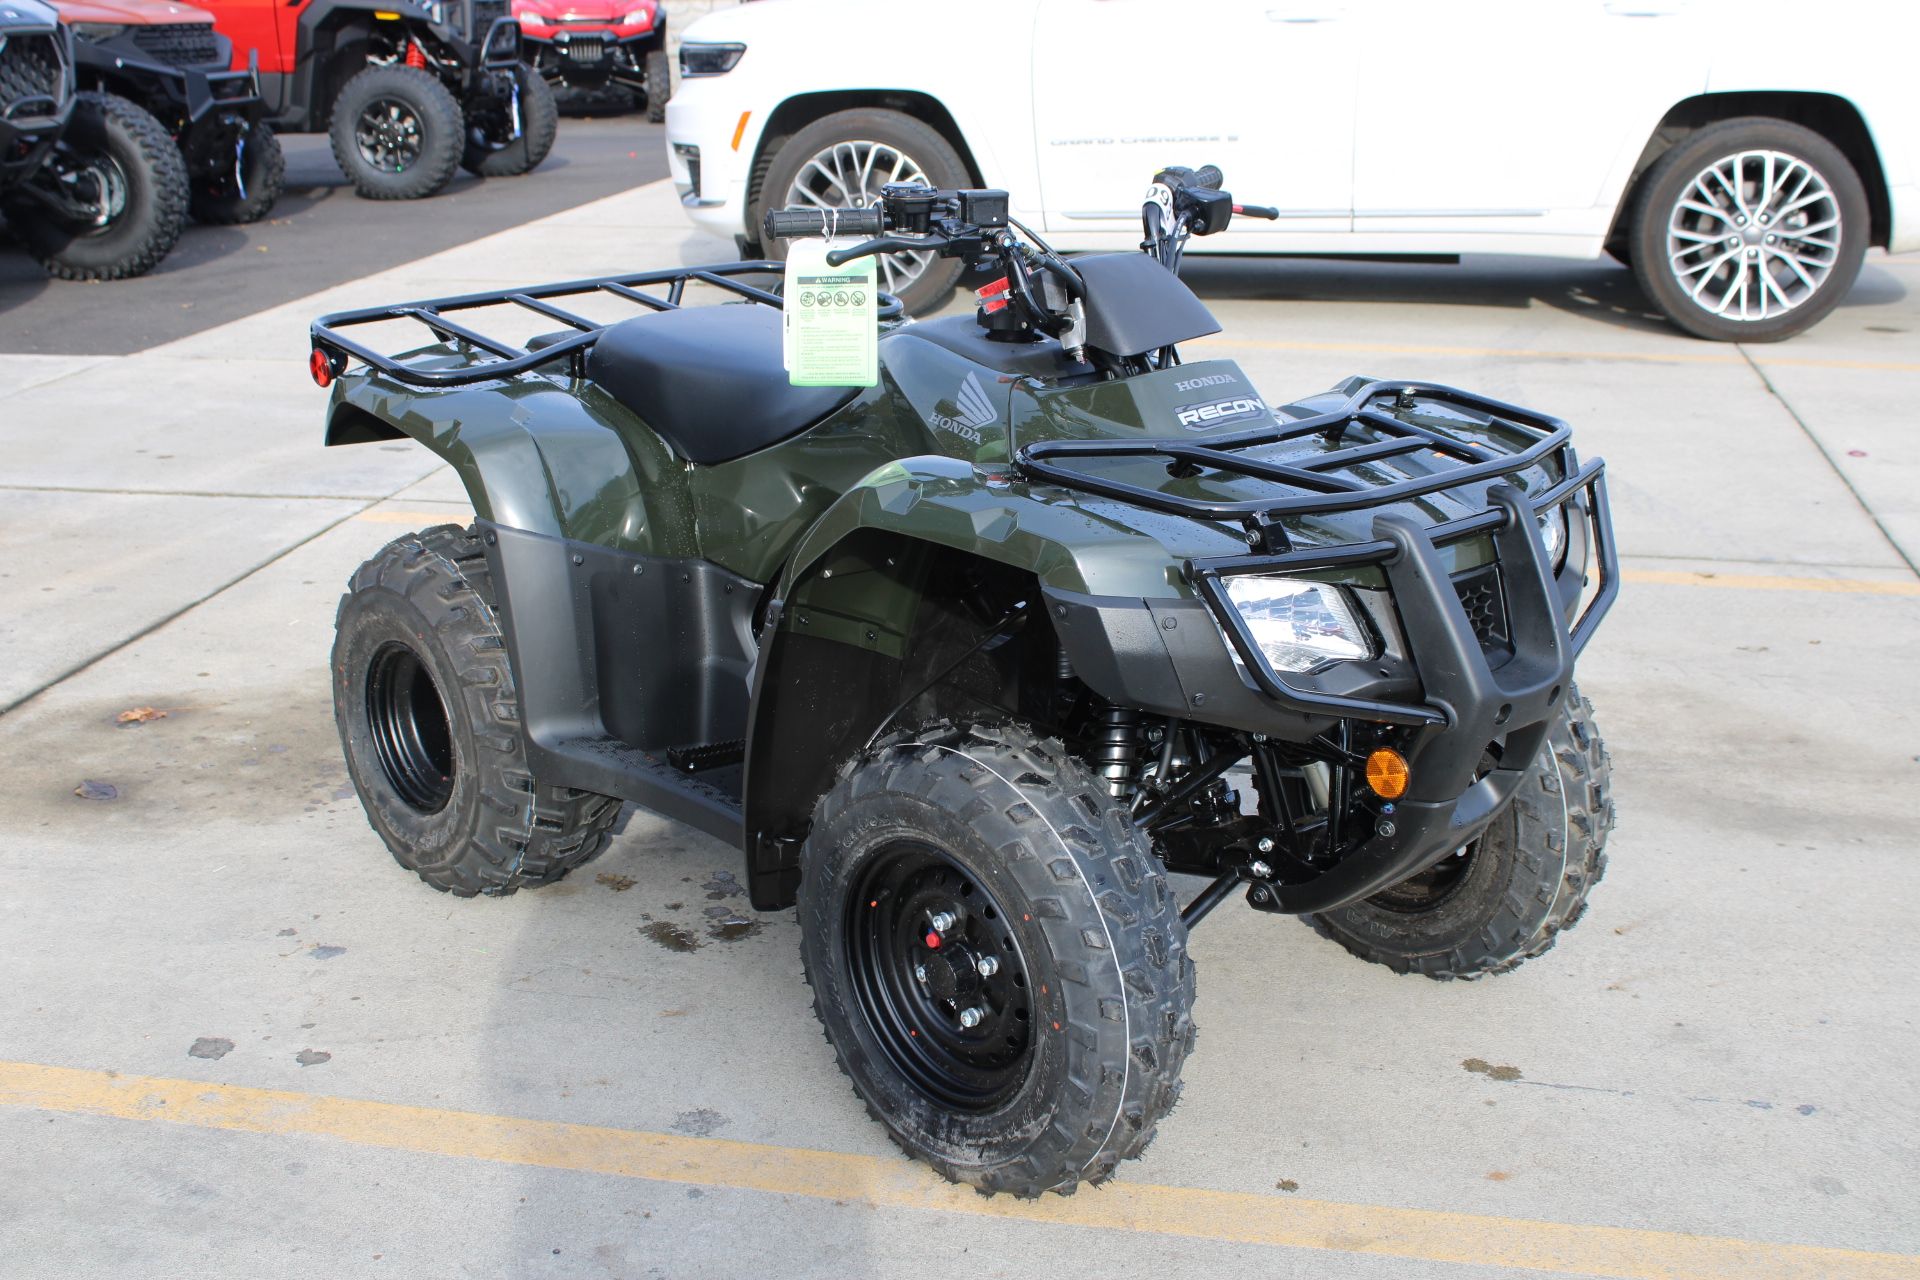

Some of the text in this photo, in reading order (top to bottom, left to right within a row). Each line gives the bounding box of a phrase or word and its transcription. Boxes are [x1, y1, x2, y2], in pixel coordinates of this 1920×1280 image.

[821, 276, 850, 284] WARNING
[1174, 374, 1238, 392] HONDA
[1177, 398, 1265, 426] RECON
[929, 411, 981, 445] HONDA
